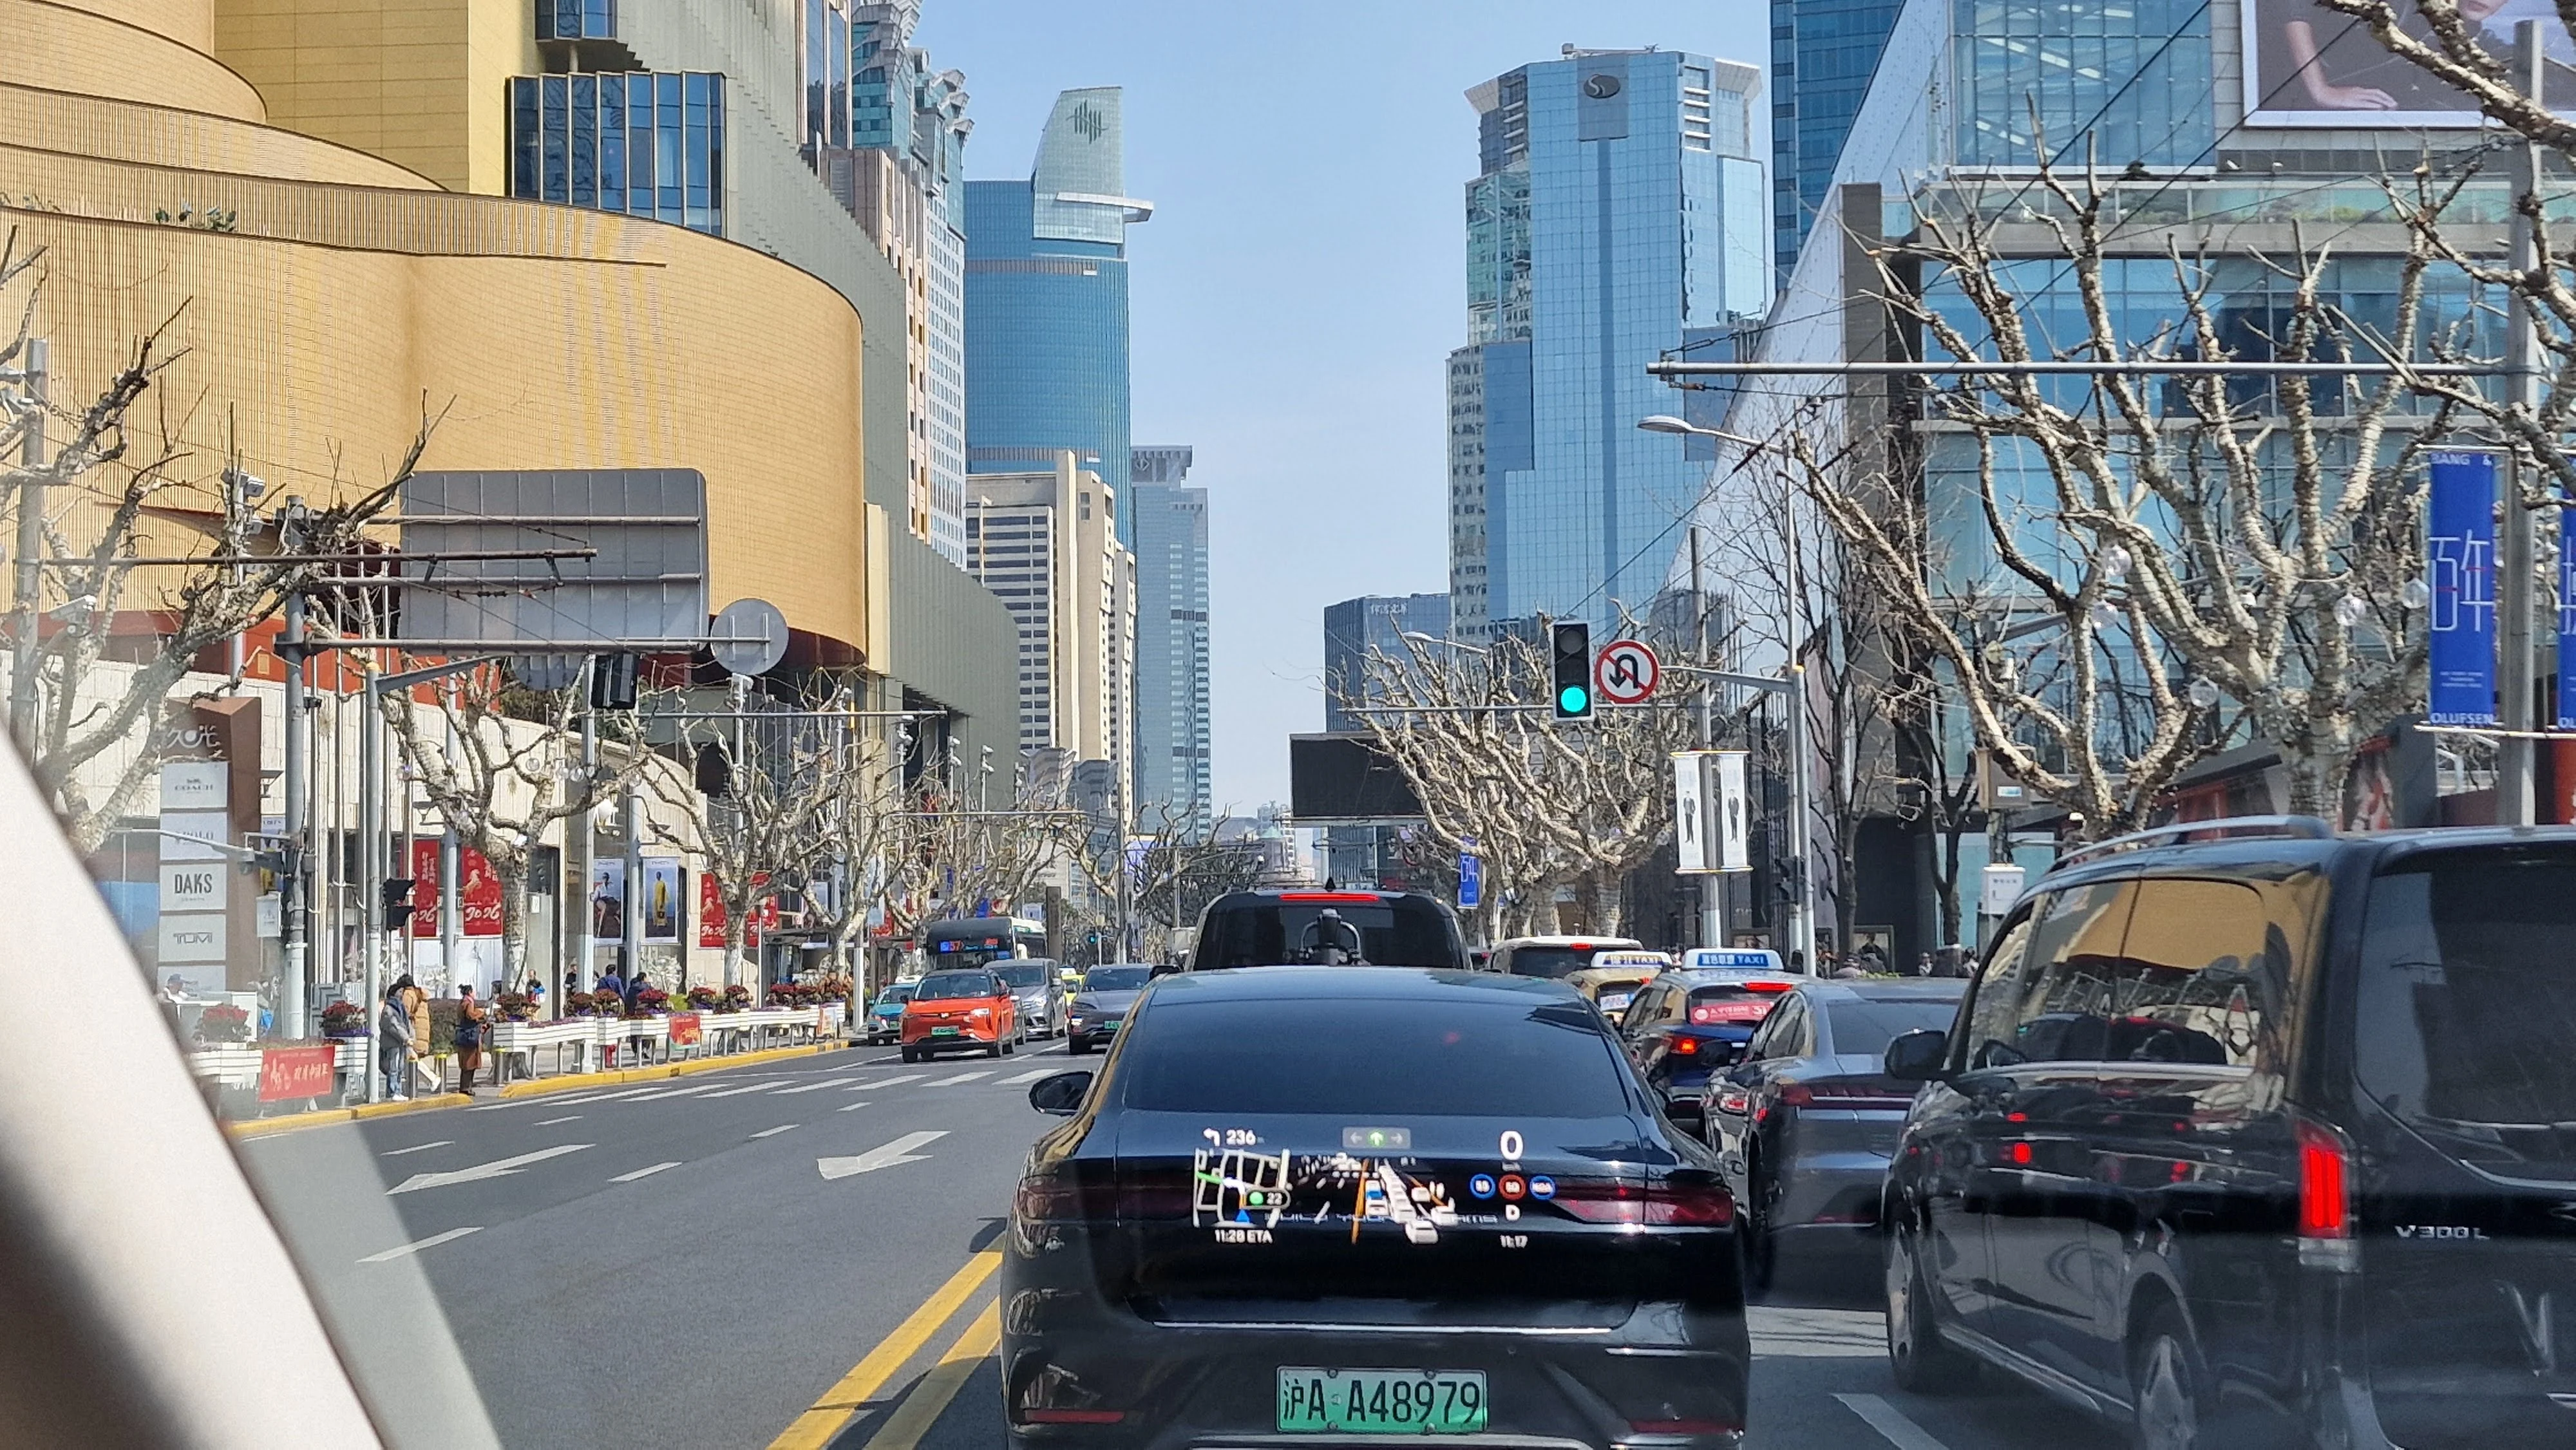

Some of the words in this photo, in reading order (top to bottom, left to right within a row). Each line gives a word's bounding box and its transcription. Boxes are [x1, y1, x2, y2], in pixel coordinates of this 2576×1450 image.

[2430, 453, 2470, 466] BANG
[2483, 455, 2492, 466] &
[2430, 712, 2493, 724] OLUFSEN
[174, 873, 213, 894] DAKS
[1736, 955, 1765, 965] TAXI
[1226, 1129, 1256, 1145] 236
[1500, 1131, 1524, 1160] 0
[1506, 1204, 1520, 1221] D
